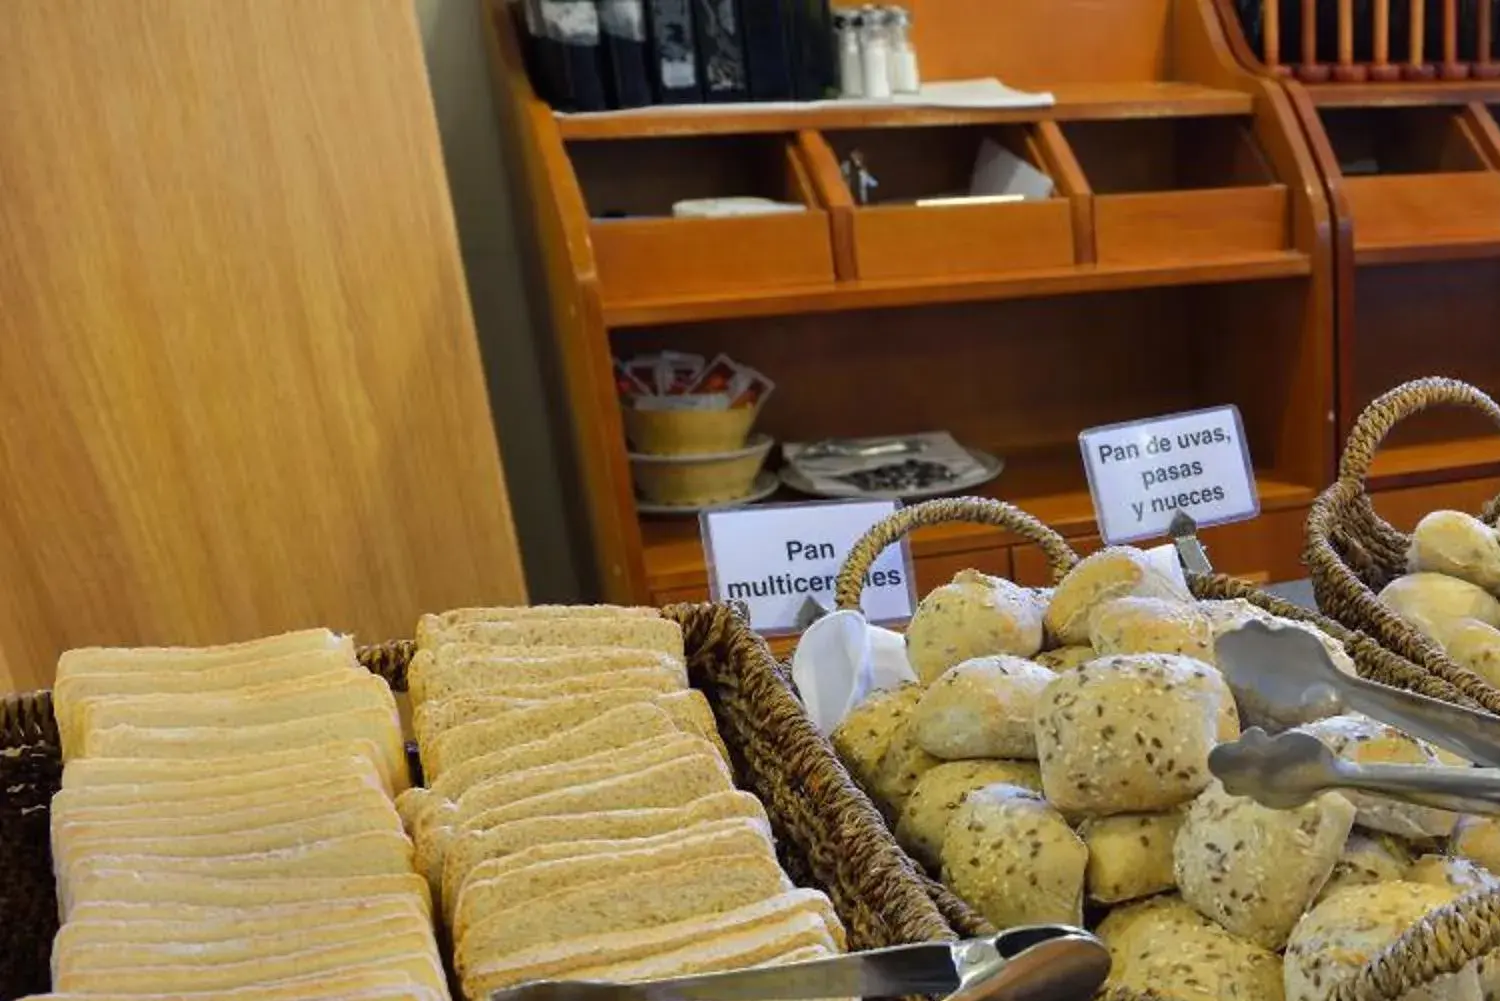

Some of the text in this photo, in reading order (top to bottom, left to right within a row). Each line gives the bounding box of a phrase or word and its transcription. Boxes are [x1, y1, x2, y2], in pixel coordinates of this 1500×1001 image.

[1099, 426, 1231, 464] Pan de uvas,
[1142, 460, 1203, 491] pasas
[1132, 485, 1225, 522] y nueces
[787, 540, 835, 561] Pan
[728, 569, 901, 598] multicerles
